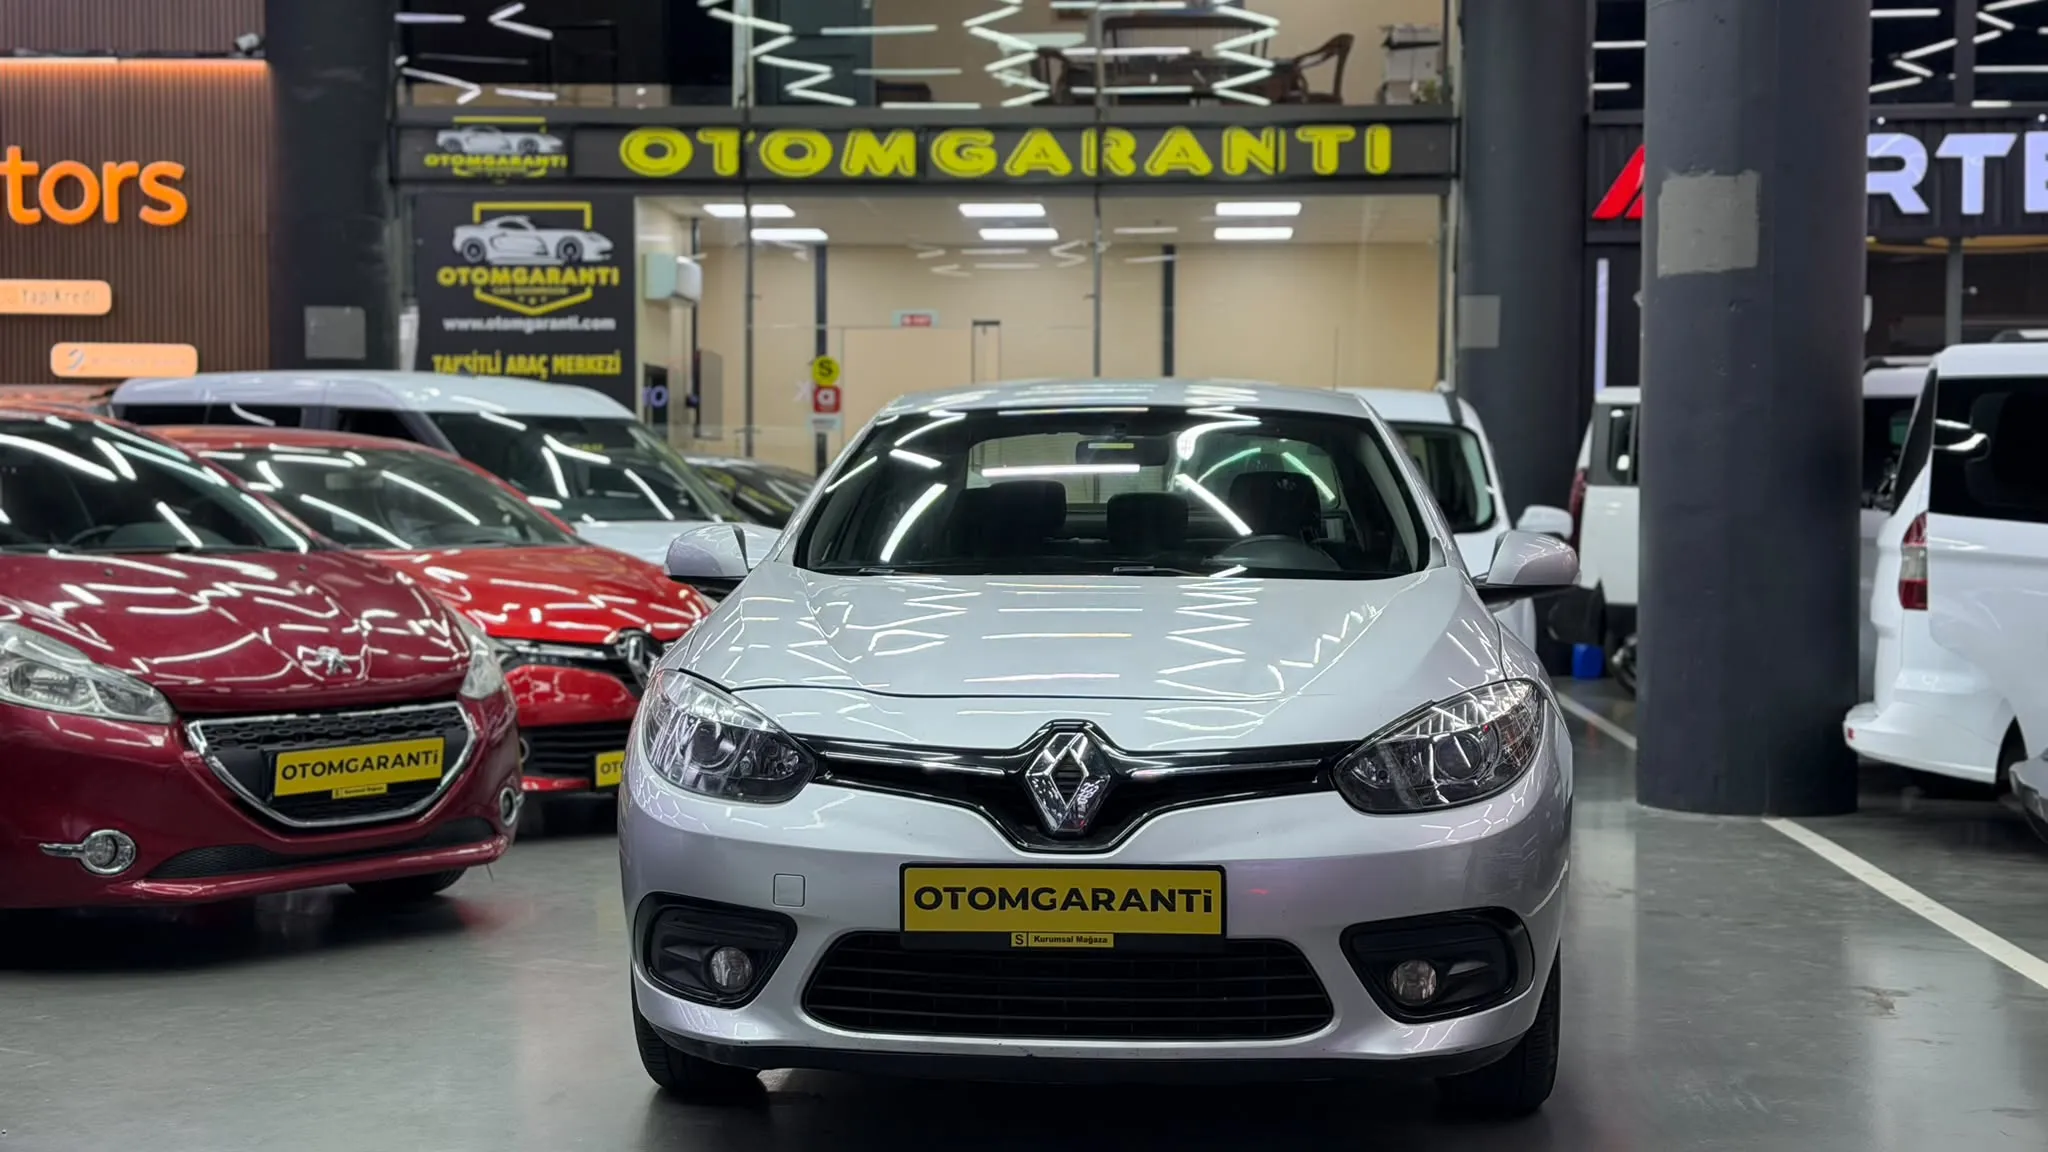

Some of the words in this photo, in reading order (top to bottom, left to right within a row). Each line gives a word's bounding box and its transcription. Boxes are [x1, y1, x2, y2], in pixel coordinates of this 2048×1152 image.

[424, 154, 569, 168] OTOMGARANTI
[619, 125, 1392, 177] OTOMGARANTI
[0, 145, 188, 227] tors
[437, 266, 619, 286] OTOMGARANTI
[443, 315, 616, 334] www.otomgaranti.com
[505, 354, 548, 381] ARAÇ
[1015, 934, 1024, 945] S
[1034, 935, 1073, 944] Kurumsal
[1076, 935, 1108, 945] Mağaza
